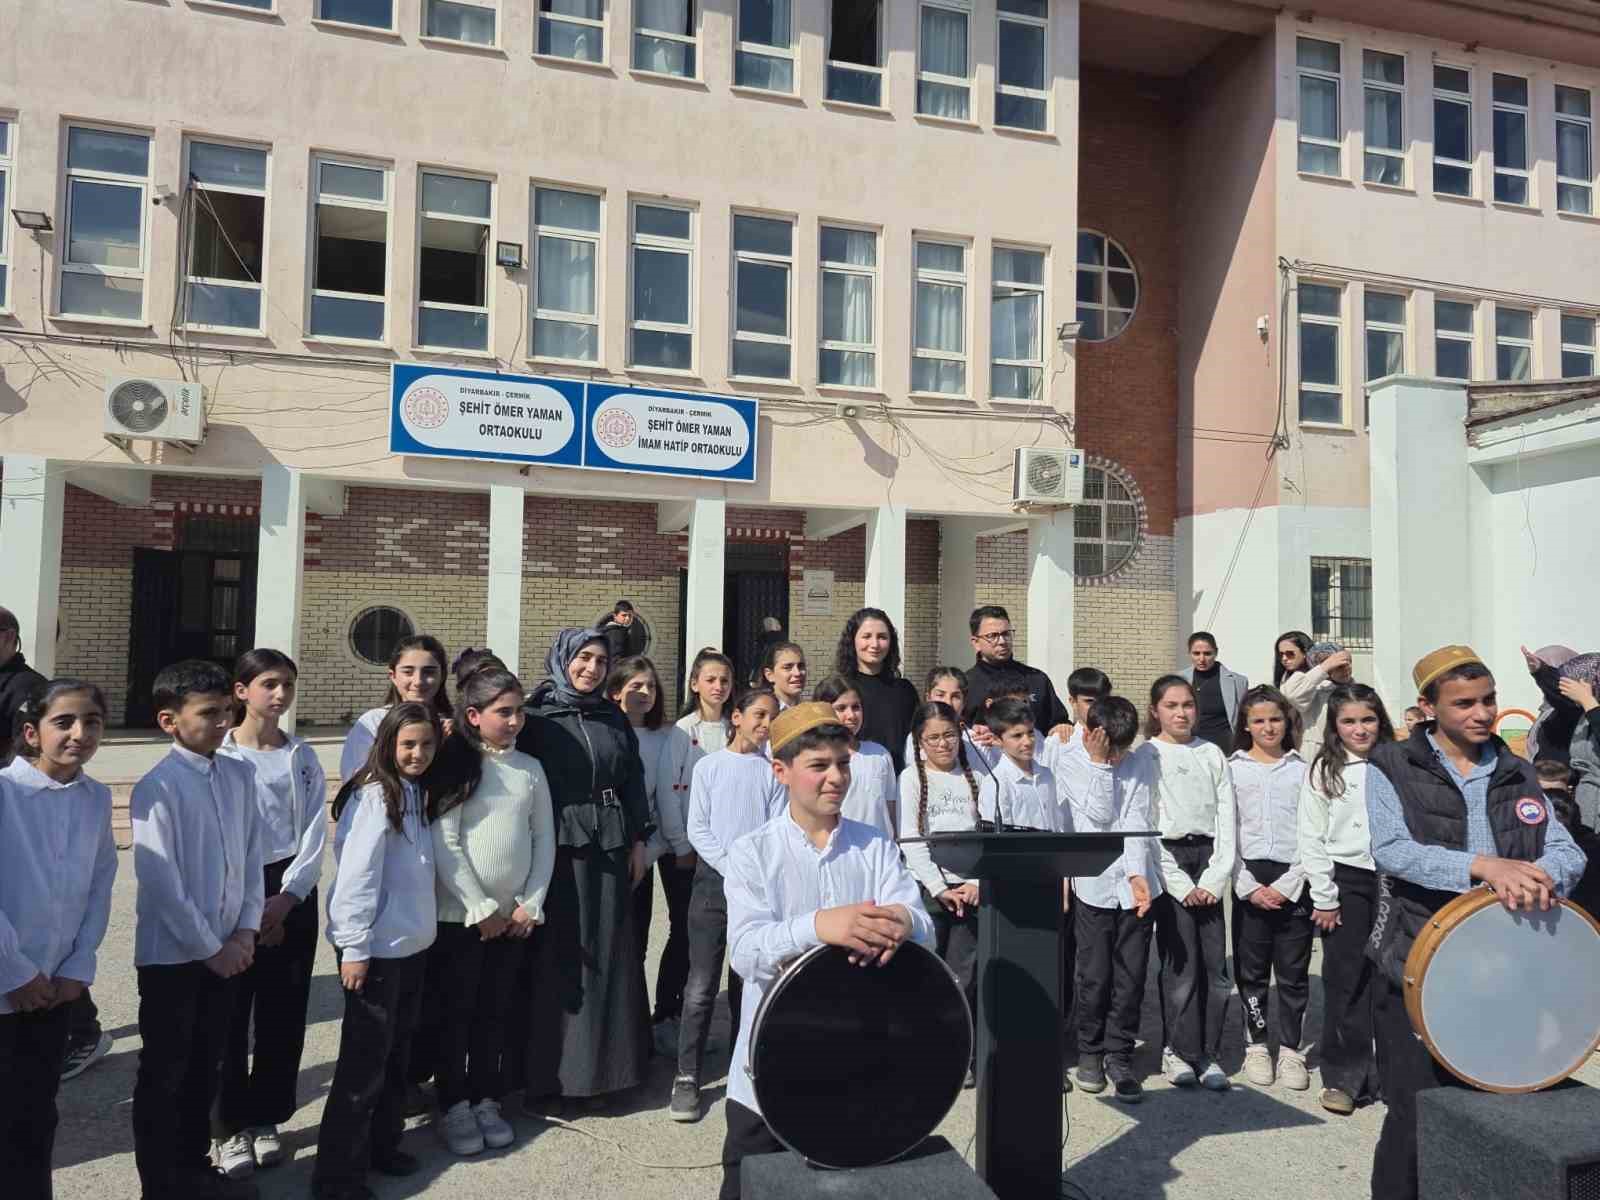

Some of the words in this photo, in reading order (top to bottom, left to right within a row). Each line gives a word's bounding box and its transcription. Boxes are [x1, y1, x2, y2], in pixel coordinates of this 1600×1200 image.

[459, 401, 491, 416] ŞEHİT
[494, 401, 524, 417] ÖMER
[527, 407, 562, 421] YAMAN
[479, 424, 543, 440] ORTAOKULU
[647, 419, 674, 433] ŞEHİT
[676, 420, 700, 435] ÖMER
[702, 424, 732, 437] YAMAN
[638, 435, 661, 449] İMAM
[664, 439, 689, 453] HATİP
[691, 443, 742, 457] ORTAOKULU
